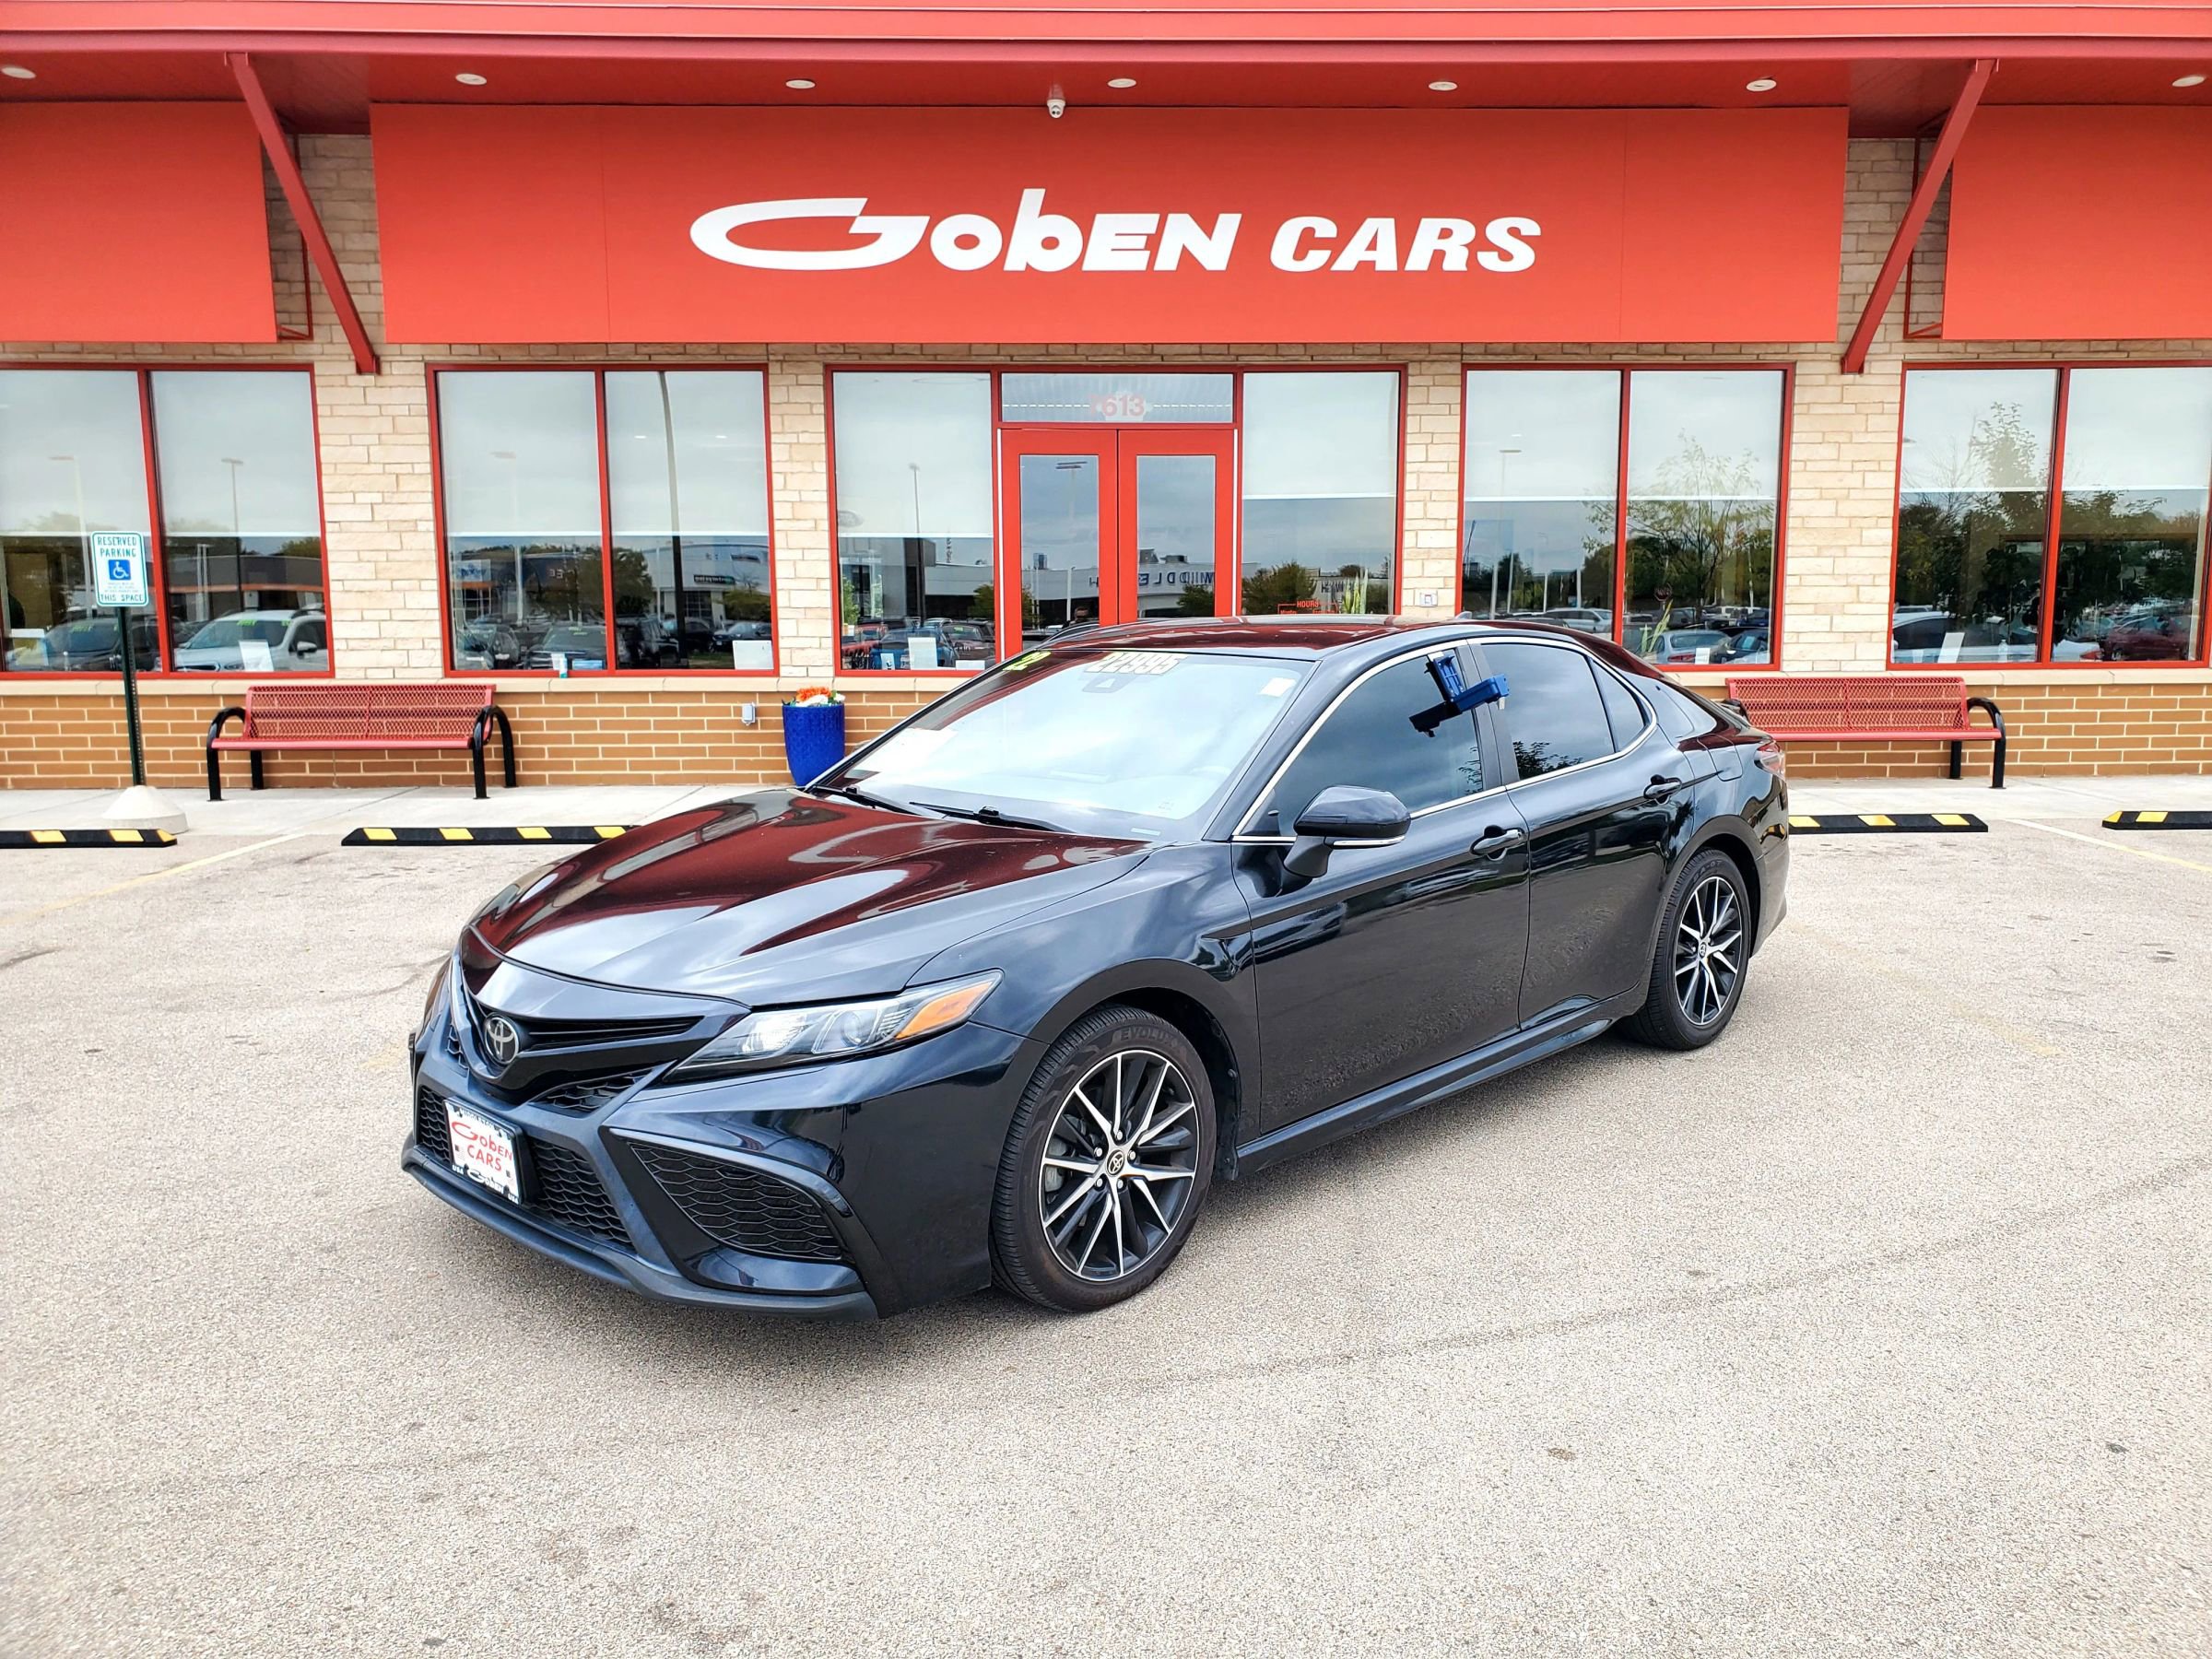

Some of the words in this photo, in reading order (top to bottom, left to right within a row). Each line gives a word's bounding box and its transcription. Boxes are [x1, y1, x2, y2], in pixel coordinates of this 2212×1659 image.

[1270, 216, 1541, 272] CARS
[1089, 394, 1145, 418] 7613
[97, 536, 137, 547] RESERVED
[100, 547, 136, 558] PARKING
[100, 594, 117, 602] THIS
[121, 594, 144, 602] SPACE
[1296, 599, 1319, 608] HOURS
[1083, 651, 1190, 676] 22995
[466, 1145, 502, 1172] CARS
